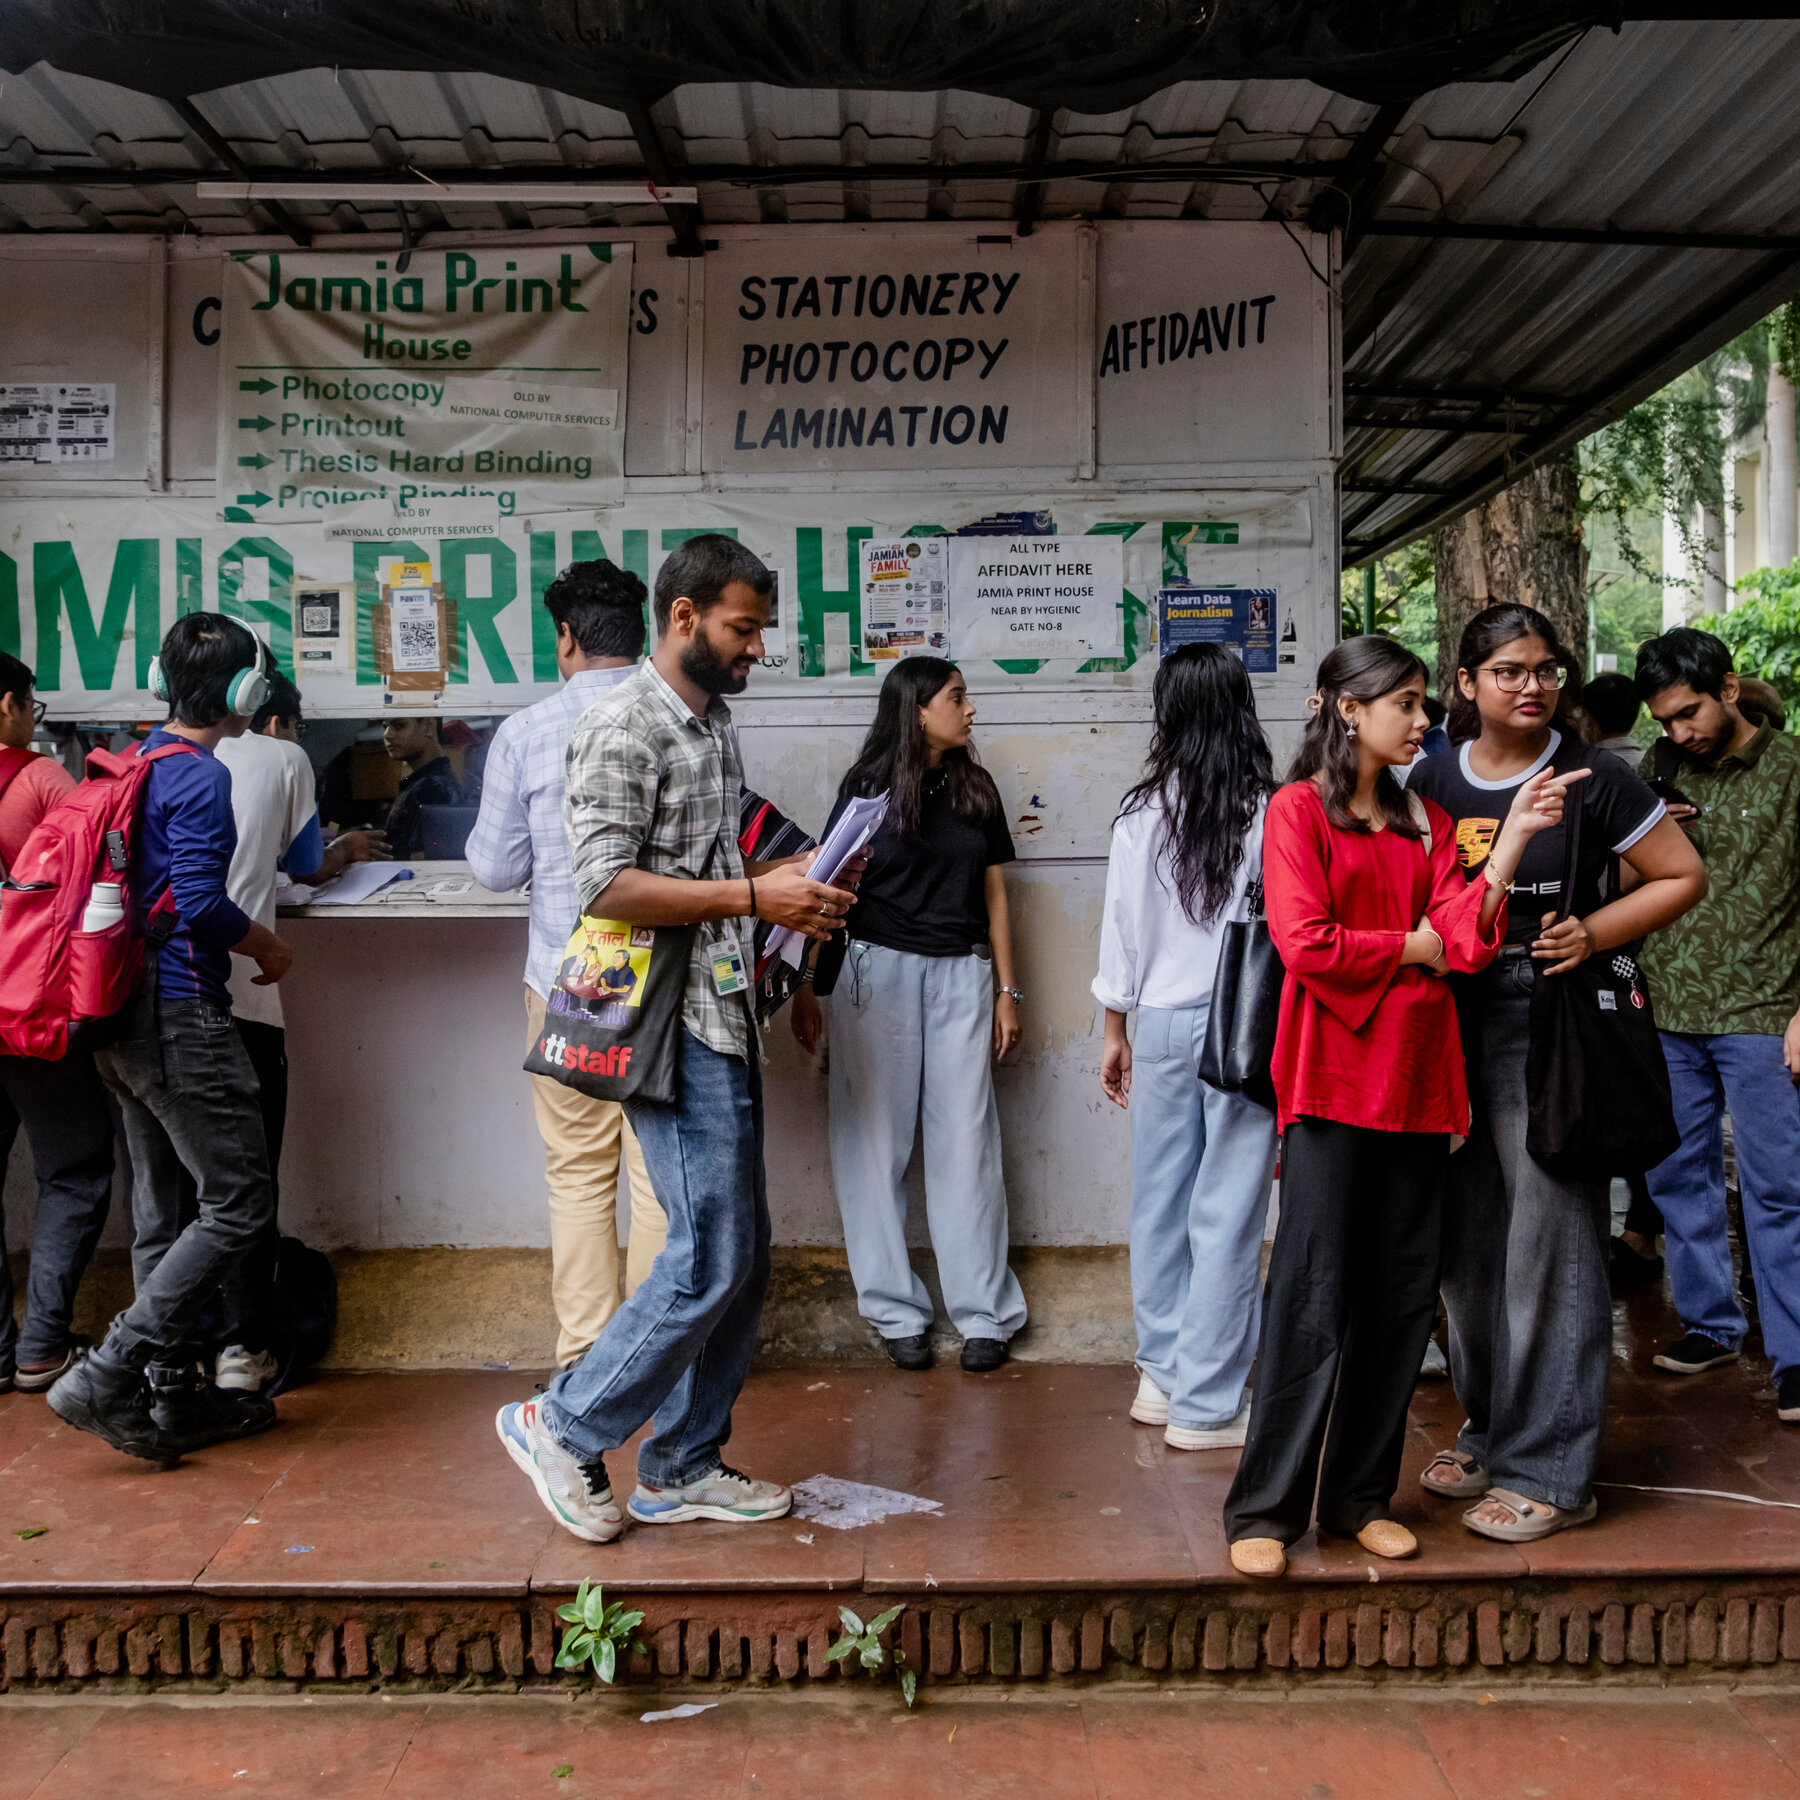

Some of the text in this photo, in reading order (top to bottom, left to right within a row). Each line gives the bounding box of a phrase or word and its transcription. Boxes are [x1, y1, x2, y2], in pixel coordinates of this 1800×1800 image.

[251, 254, 424, 313] Jamia
[445, 252, 590, 313] Print
[738, 272, 1020, 321] STATIONERY
[363, 323, 472, 361] House
[1100, 294, 1276, 378] AFFIDAVIT
[740, 337, 1010, 386] PHOTOCOPY
[282, 375, 445, 407] Photocopy
[513, 391, 551, 404] OLD BY
[450, 405, 611, 426] NATIONAL COMPUTER SERVICES
[281, 413, 406, 437] Printout
[734, 404, 1009, 450] LAMINATION
[279, 449, 592, 480] Thesis Hard Binding
[419, 508, 431, 518] BY
[332, 525, 494, 538] NATIONAL COMPUTER SERVICES
[868, 549, 904, 562] JAMIAN
[1009, 543, 1061, 554] ALL TYPE
[871, 559, 909, 573] FAMILY
[977, 563, 1093, 577] AFFIDAVIT HERE
[976, 586, 1094, 598] JAMIA PRINT HOUSE
[1167, 594, 1232, 605] Learn Data
[991, 605, 1081, 616] NEAR BY HYGIENIC
[1166, 605, 1234, 620] Journalism
[1010, 622, 1063, 632] GATE NO-8
[598, 930, 627, 947] ताल
